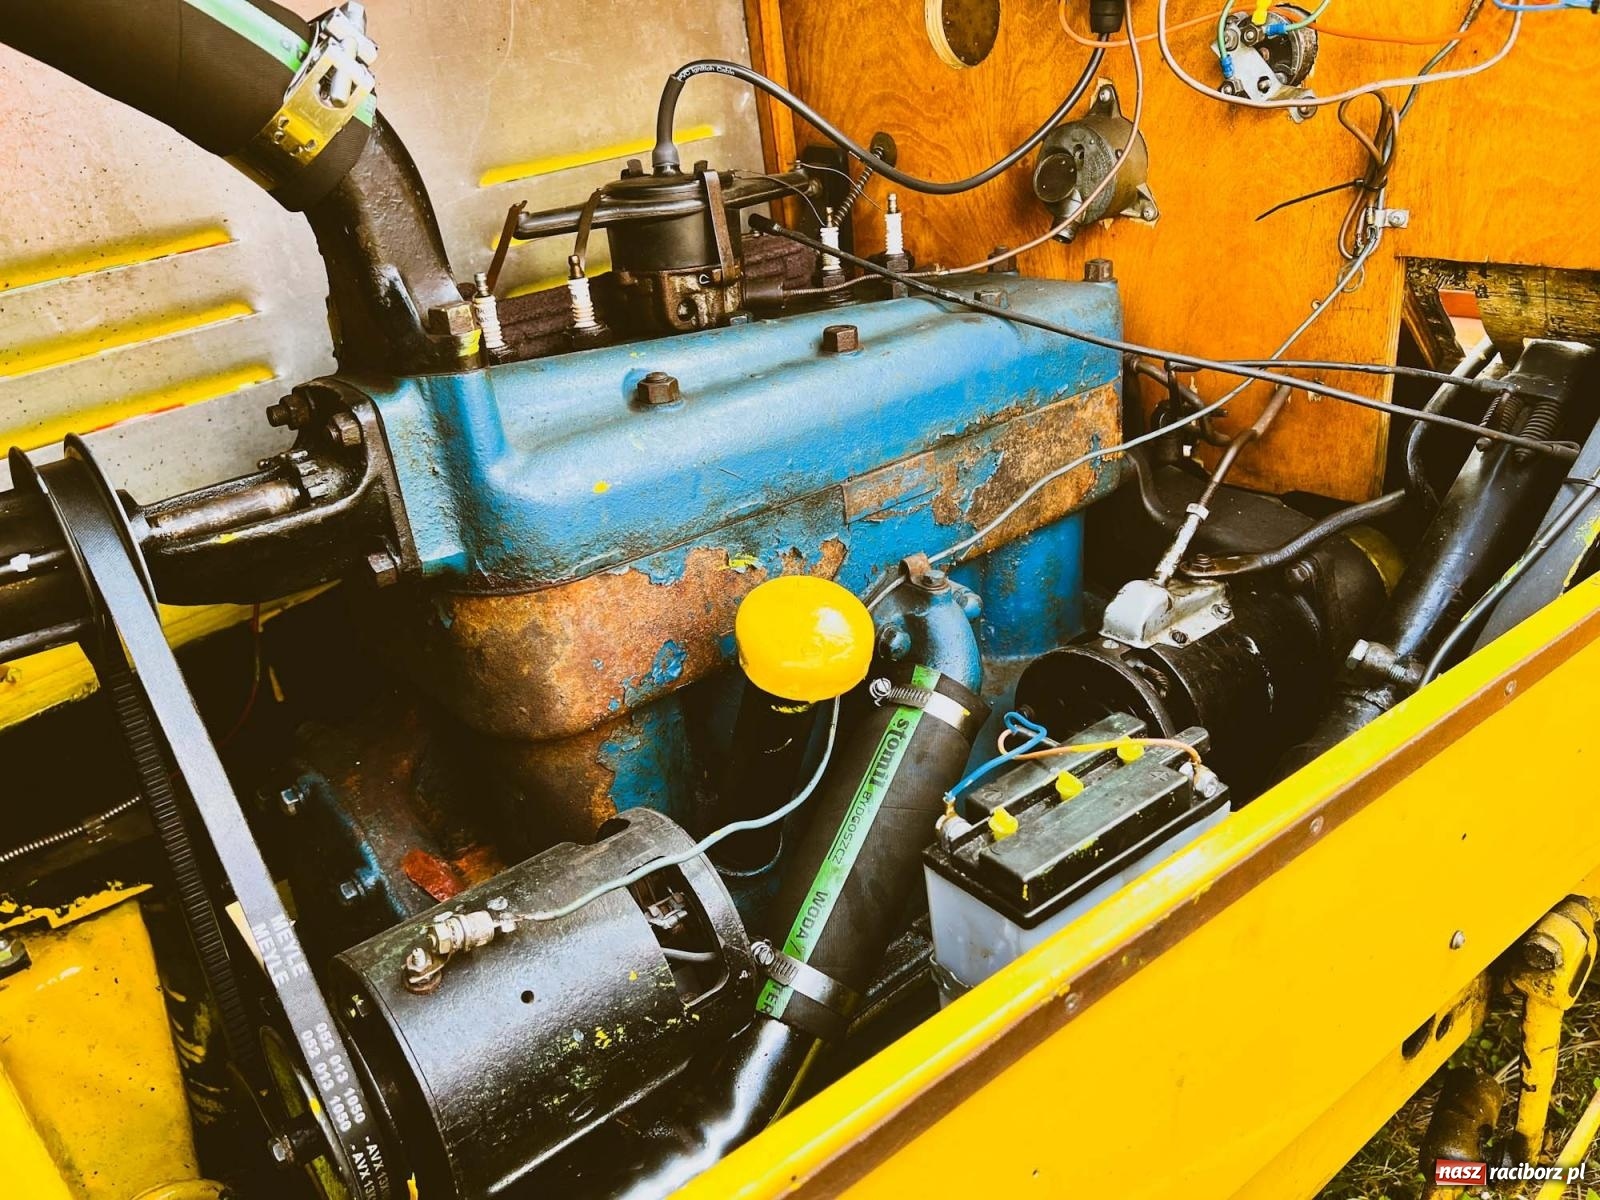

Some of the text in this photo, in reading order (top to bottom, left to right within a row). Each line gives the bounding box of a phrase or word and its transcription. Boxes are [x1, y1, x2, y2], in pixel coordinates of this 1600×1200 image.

[676, 69, 691, 82] PVC
[869, 718, 909, 788] stomil
[832, 791, 872, 865] BYDGOSZCZ
[271, 913, 309, 977] MEYLE
[796, 891, 829, 939] WODA
[252, 922, 290, 988] MEYLE
[761, 983, 783, 1014] TER
[301, 1029, 321, 1058] 052
[314, 1062, 335, 1092] 013
[329, 1095, 352, 1132] 1050
[315, 1022, 335, 1052] 052
[329, 1054, 349, 1083] 013
[343, 1087, 366, 1124] 1050
